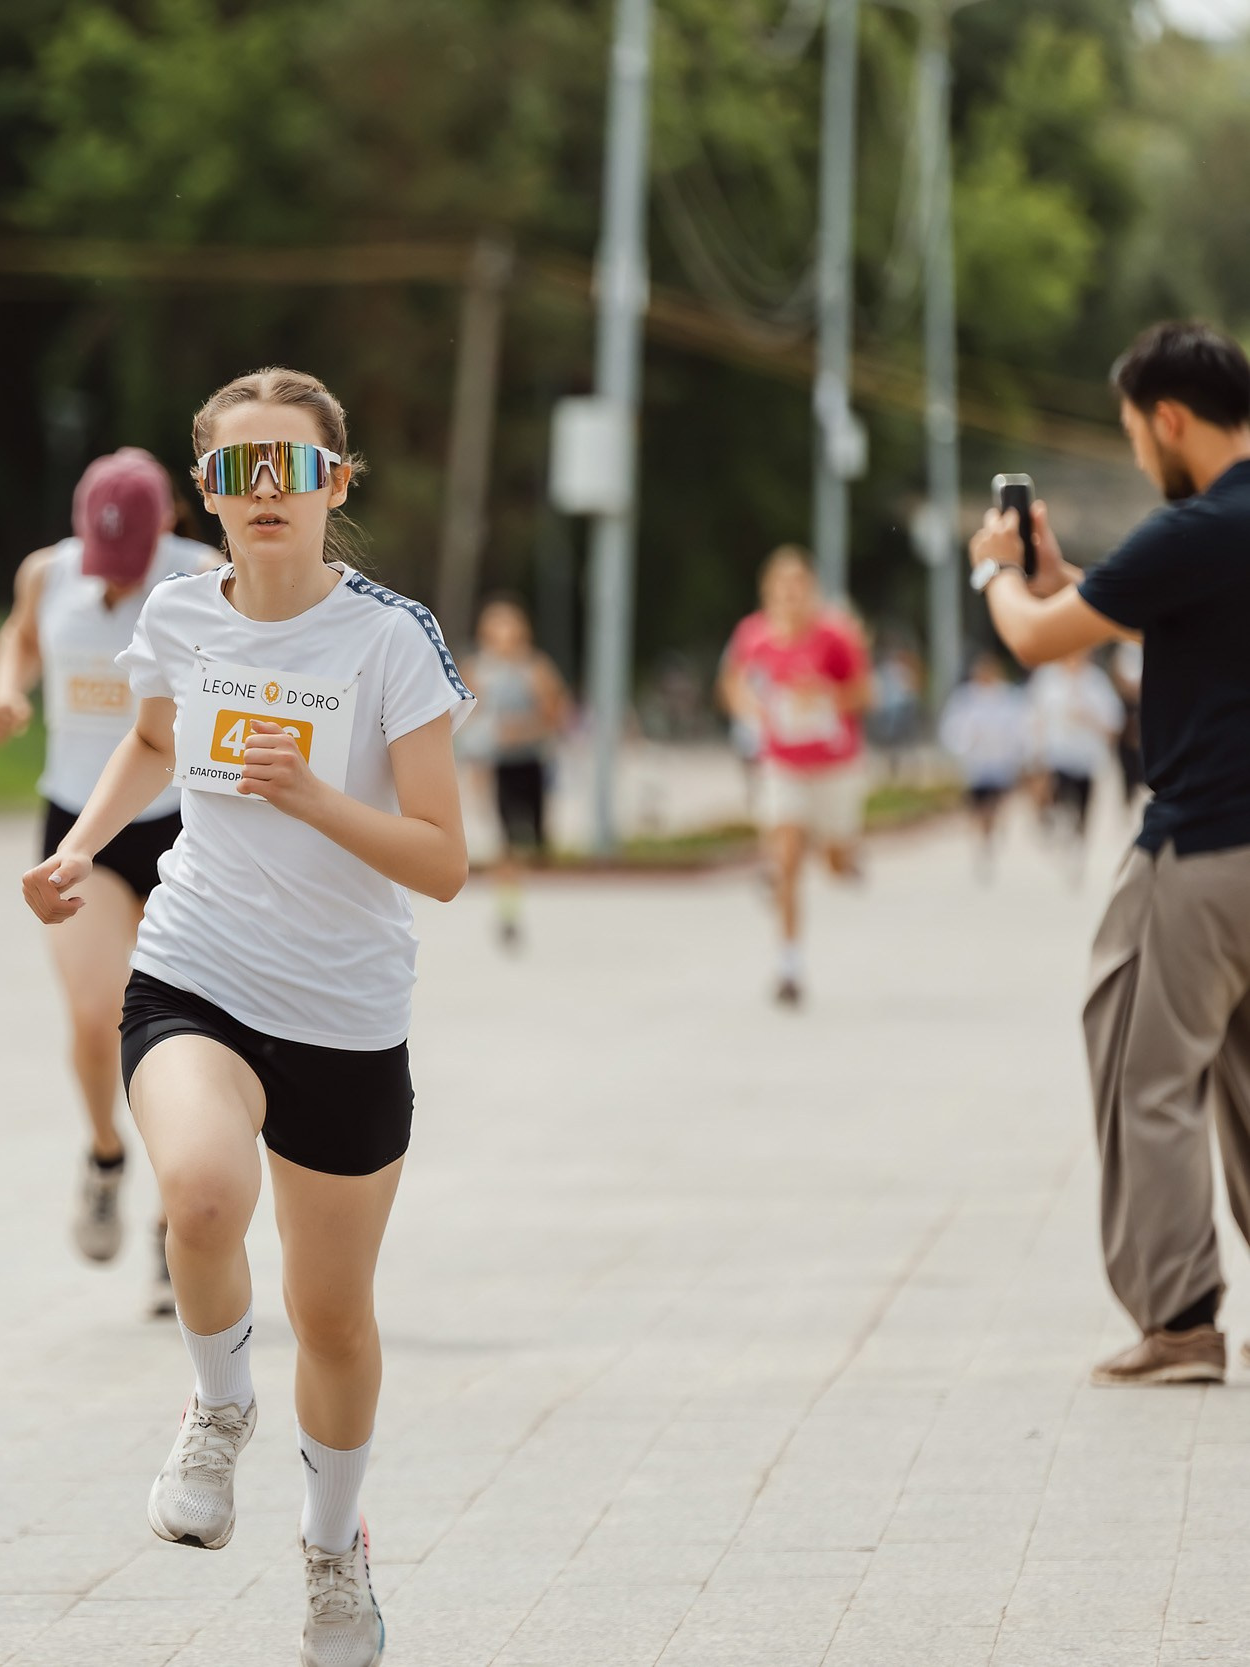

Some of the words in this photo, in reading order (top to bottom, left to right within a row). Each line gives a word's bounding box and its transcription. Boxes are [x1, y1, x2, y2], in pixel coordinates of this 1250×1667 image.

[202, 679, 257, 699] LEONE
[287, 690, 340, 710] D'ORO
[189, 766, 244, 781] БЛАГОТВОР
